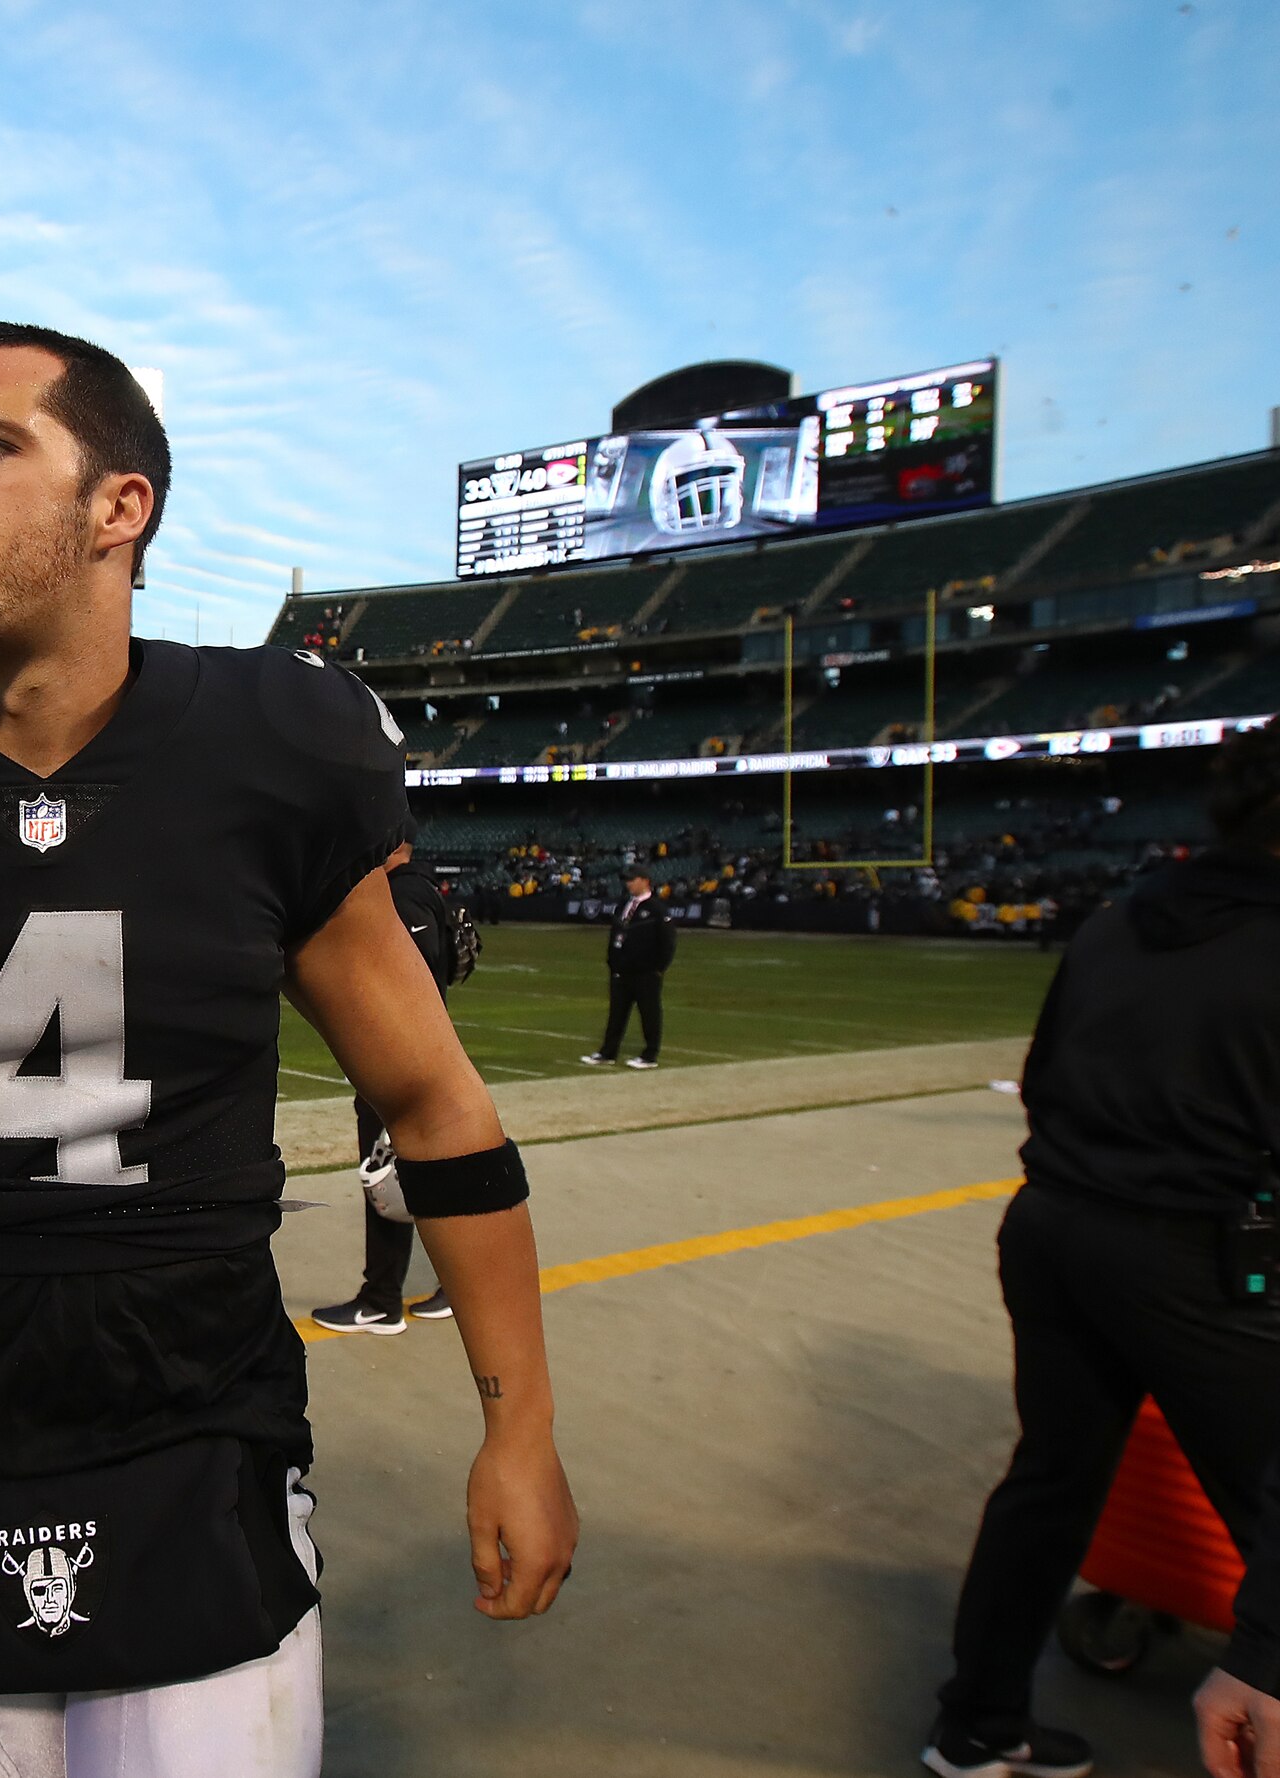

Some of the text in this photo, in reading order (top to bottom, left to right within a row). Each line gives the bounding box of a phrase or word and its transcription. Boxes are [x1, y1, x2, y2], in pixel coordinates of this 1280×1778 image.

[464, 477, 492, 502] 33
[519, 467, 547, 492] 40
[891, 742, 958, 766] OAK 33
[621, 760, 718, 778] THE OAKLAND RAIDERS
[27, 818, 60, 841] NFL
